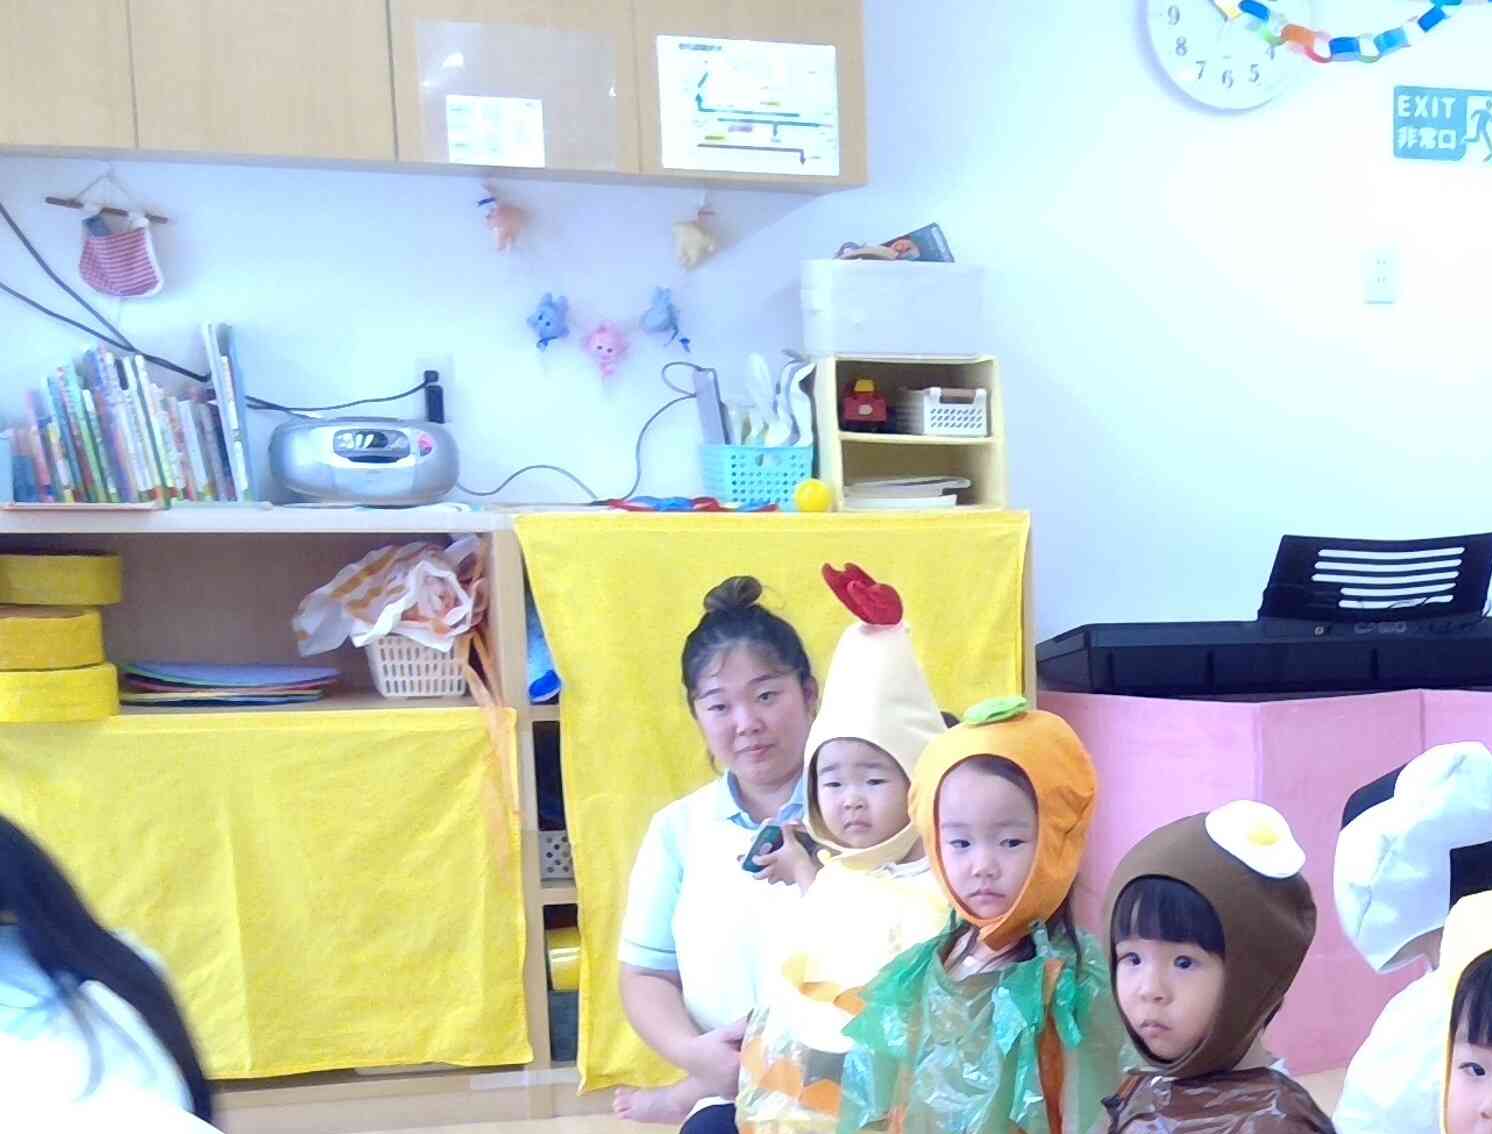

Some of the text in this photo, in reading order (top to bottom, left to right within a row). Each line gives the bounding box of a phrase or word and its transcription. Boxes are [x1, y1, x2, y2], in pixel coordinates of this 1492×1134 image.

[1167, 5, 1180, 25] 9
[1175, 36, 1187, 56] 8
[1195, 60, 1207, 80] 7
[1222, 70, 1233, 88] 6
[1249, 64, 1260, 82] 5
[1398, 95, 1456, 119] EXIT
[1398, 127, 1457, 150] 非常口
